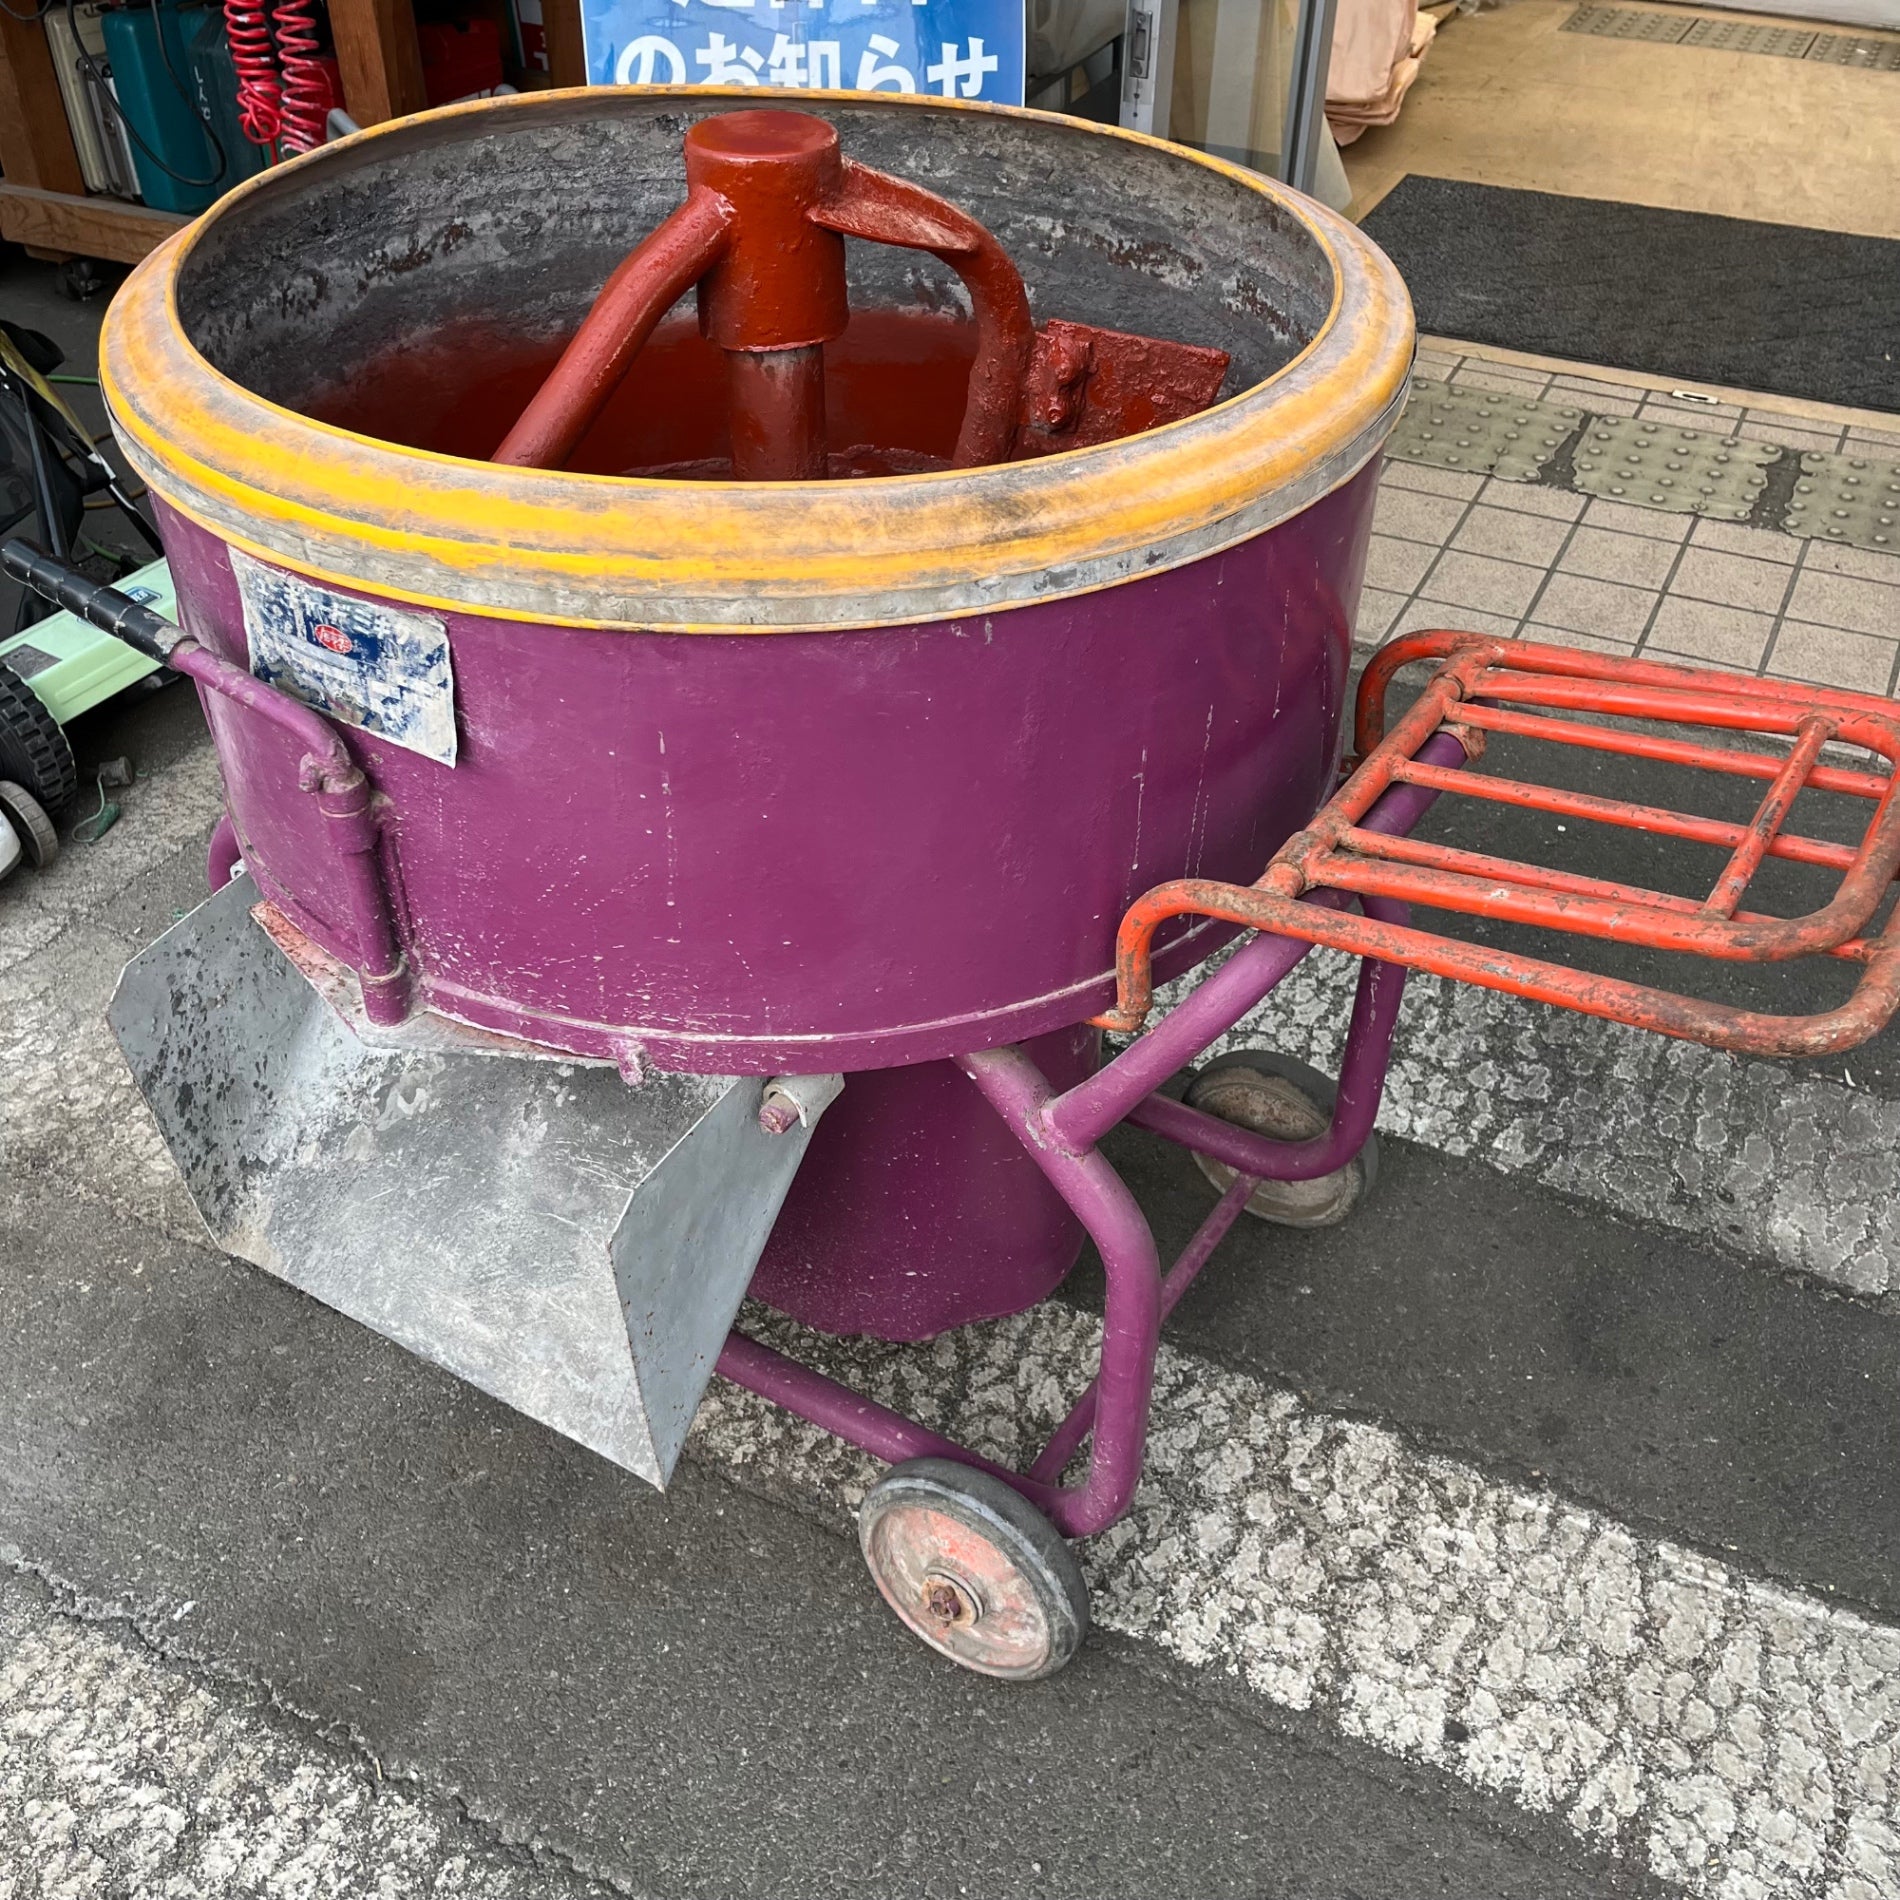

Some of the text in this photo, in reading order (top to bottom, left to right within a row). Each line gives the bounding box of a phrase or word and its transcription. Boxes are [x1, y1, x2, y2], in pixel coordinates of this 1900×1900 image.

[616, 32, 998, 98] のお知らせ
